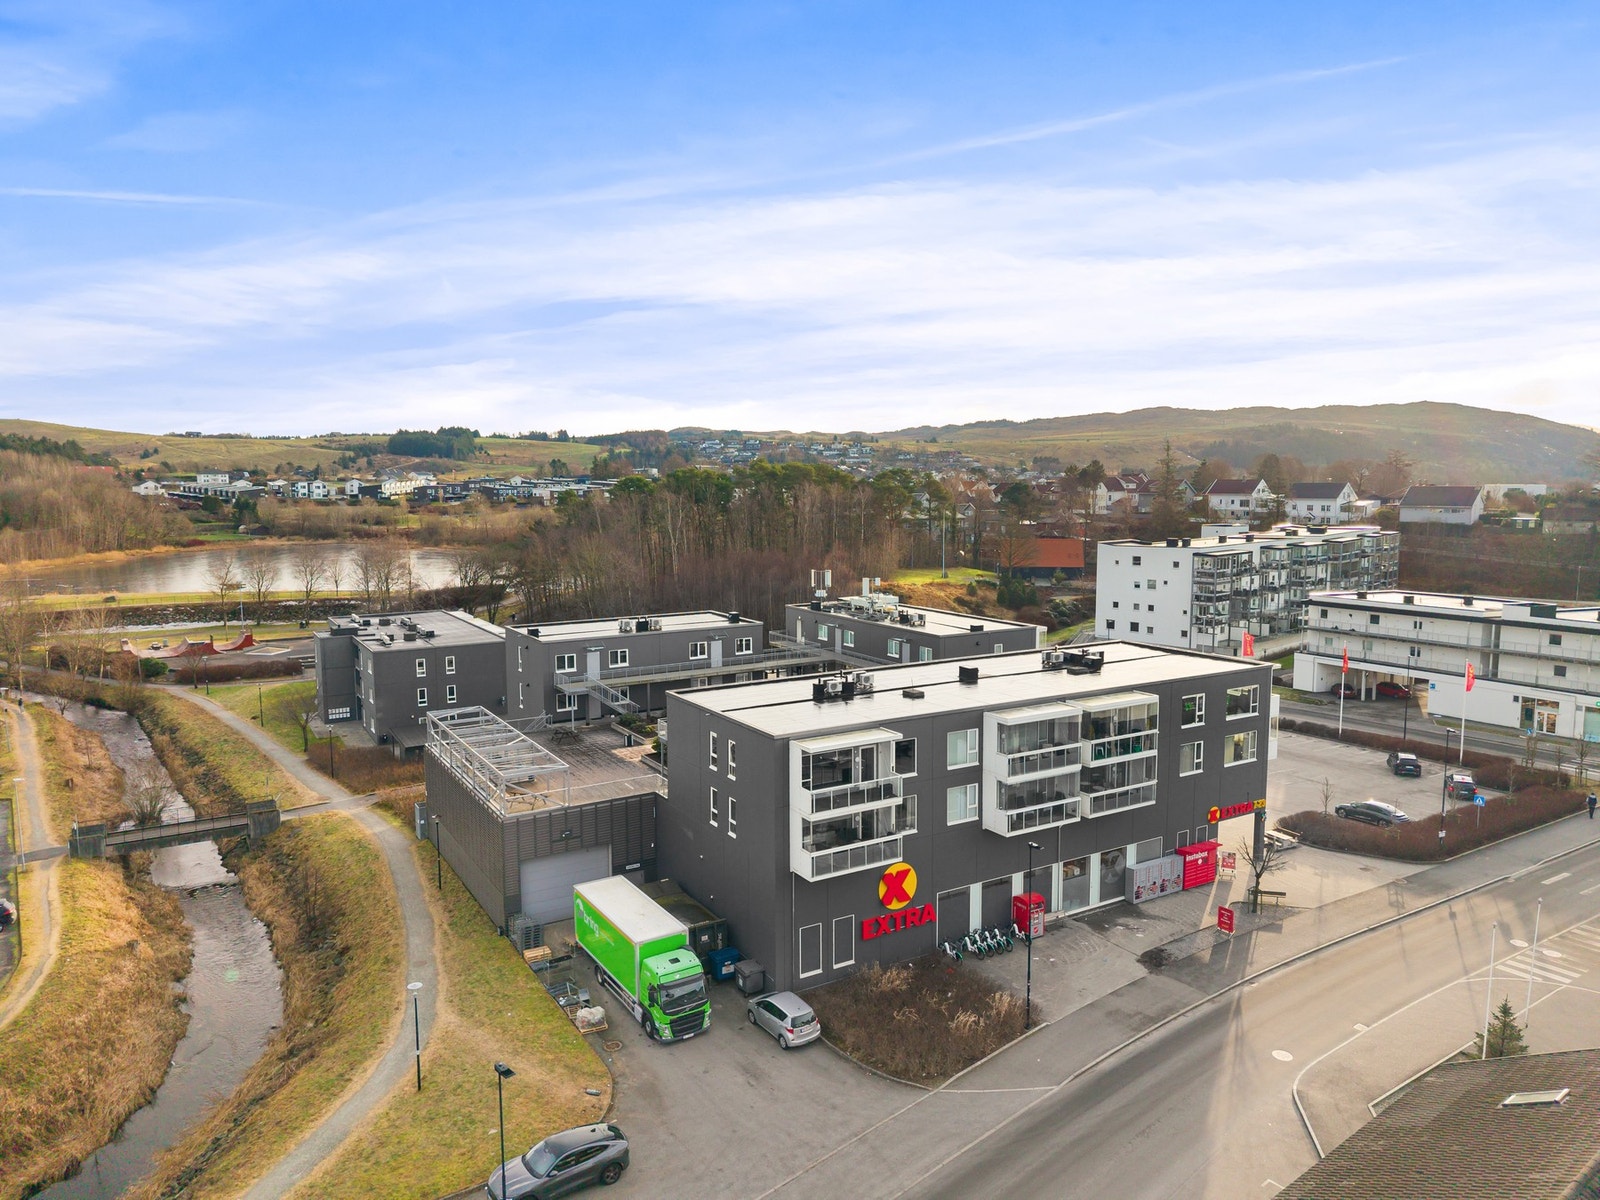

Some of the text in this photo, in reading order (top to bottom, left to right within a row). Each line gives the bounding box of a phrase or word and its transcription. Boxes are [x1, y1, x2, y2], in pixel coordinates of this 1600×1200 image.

[1221, 801, 1253, 818] EXTRA
[1186, 851, 1208, 861] instabox
[882, 868, 912, 906] X
[584, 910, 599, 937] bring
[862, 902, 936, 940] EXTRA
